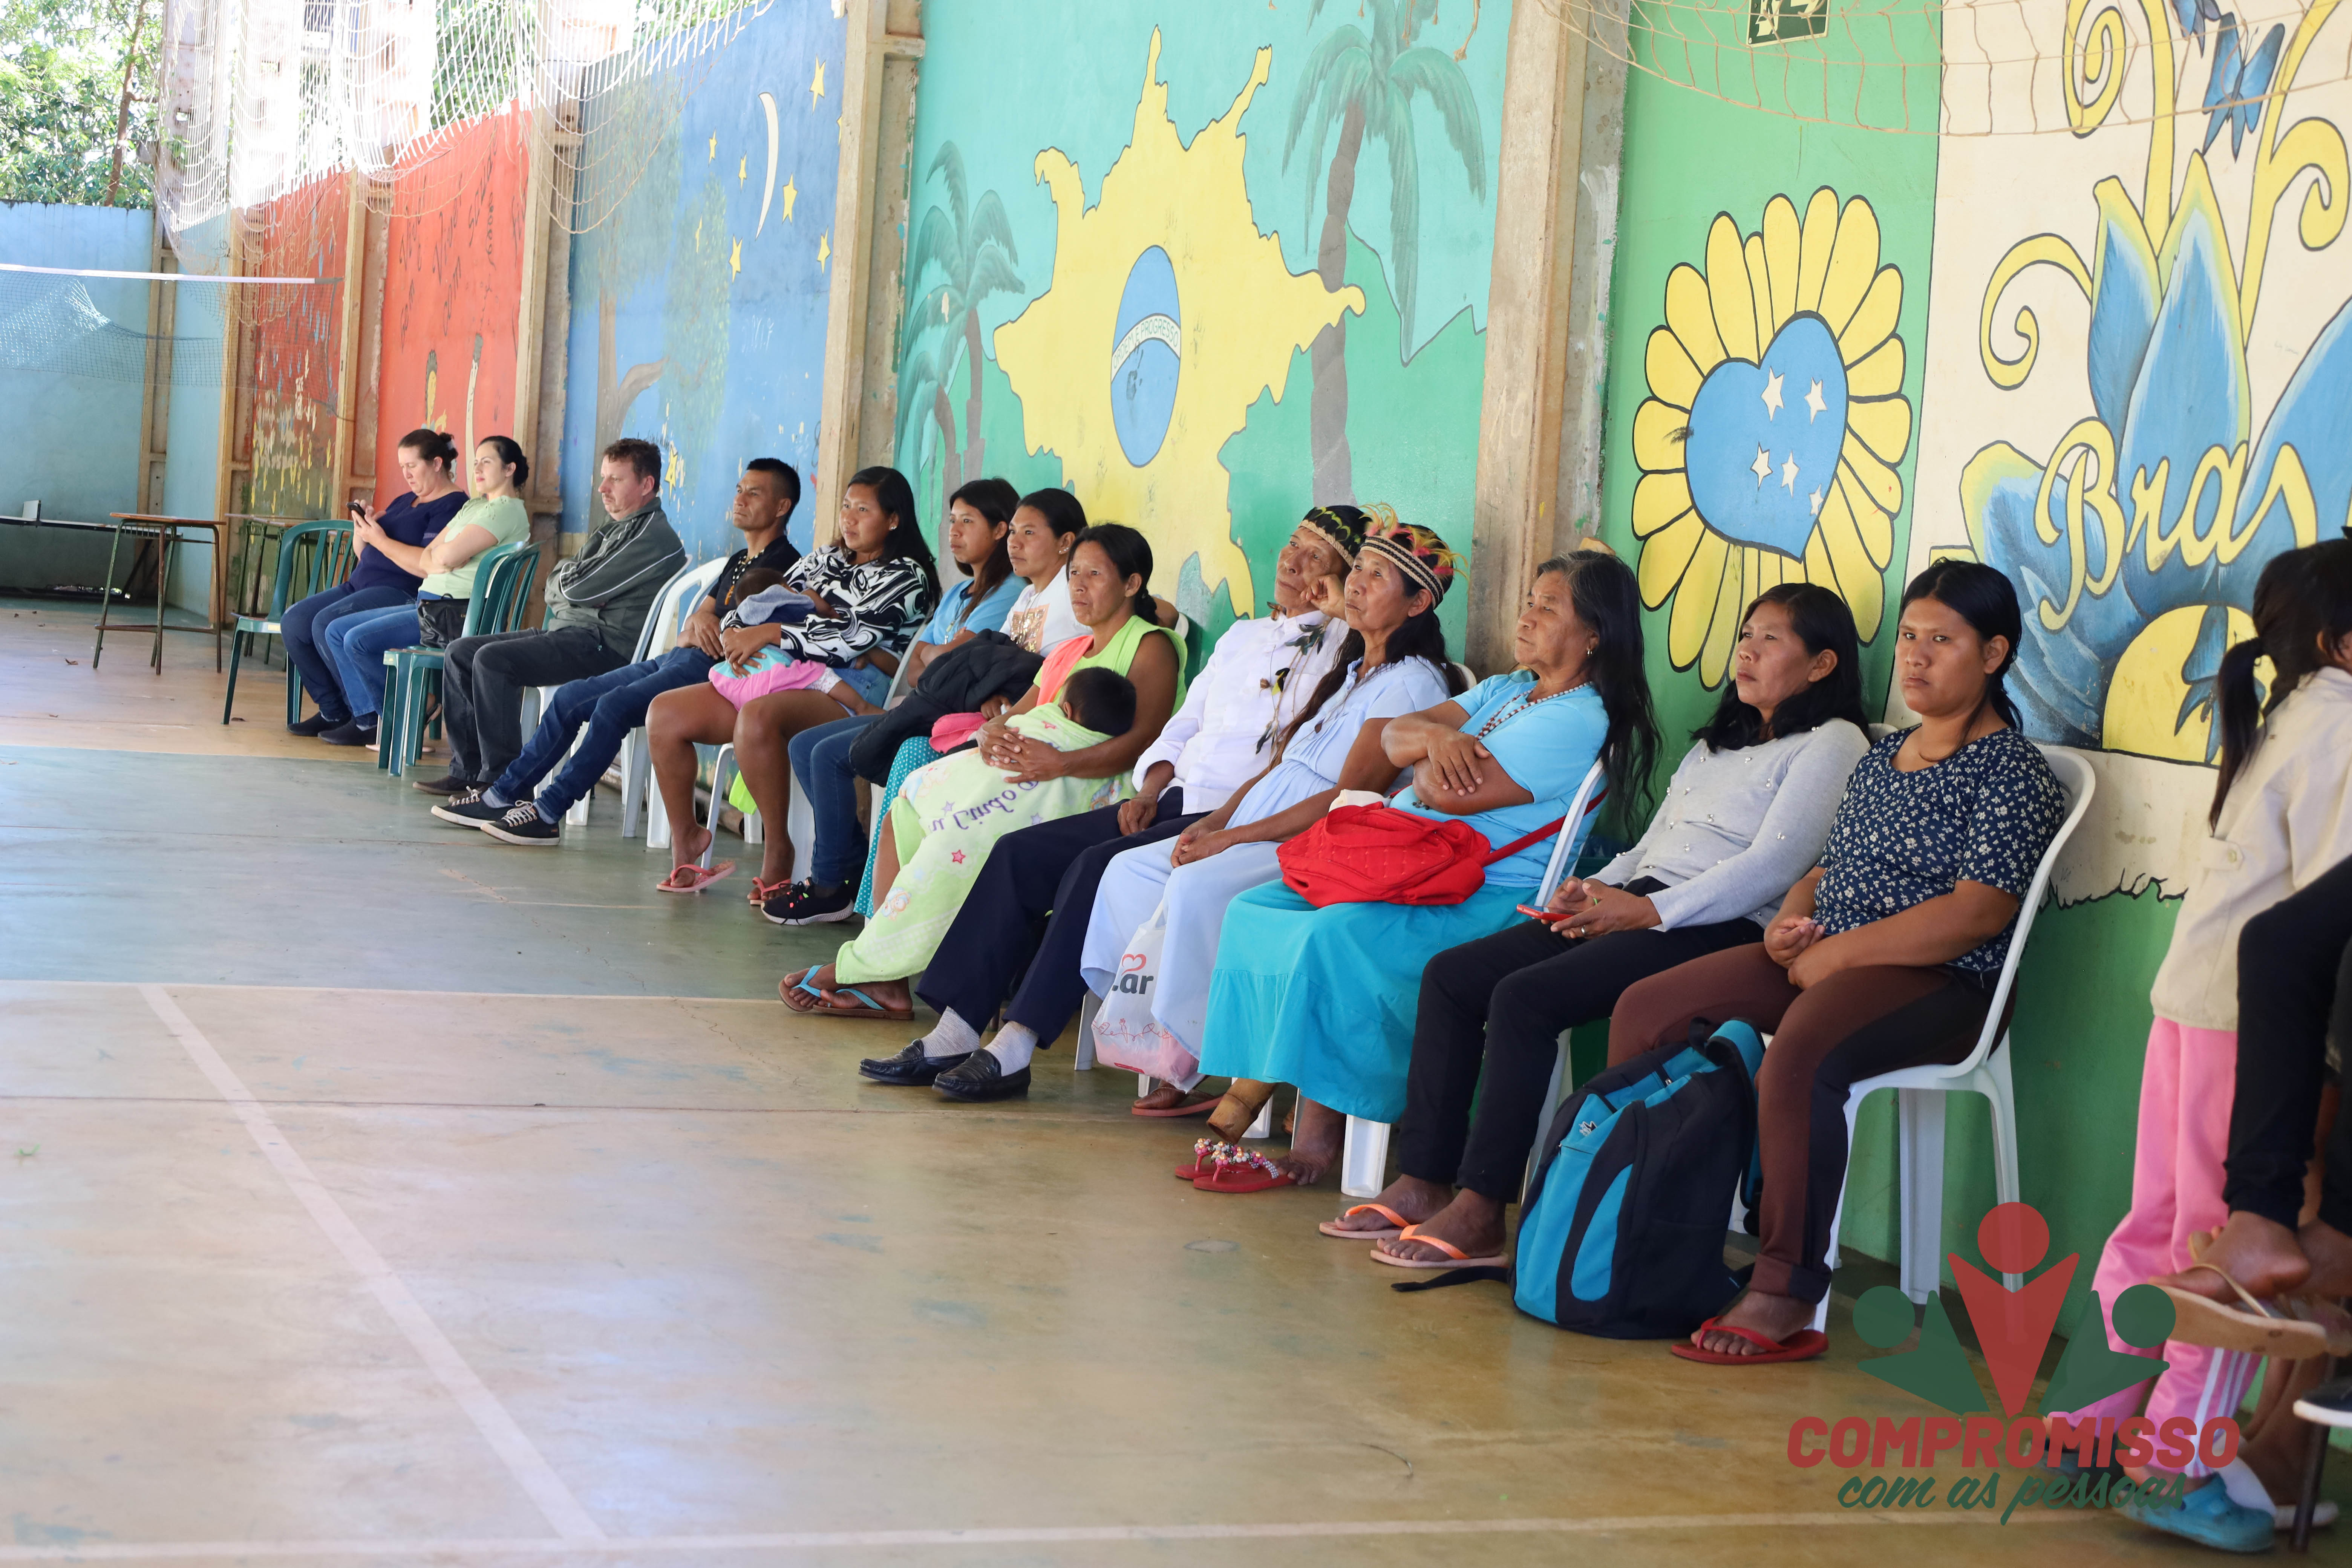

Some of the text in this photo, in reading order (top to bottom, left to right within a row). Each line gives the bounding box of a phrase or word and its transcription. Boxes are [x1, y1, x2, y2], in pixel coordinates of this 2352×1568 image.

[1113, 318, 1179, 369] ORDEM E PROGRESSO
[2033, 416, 2352, 634] Bras
